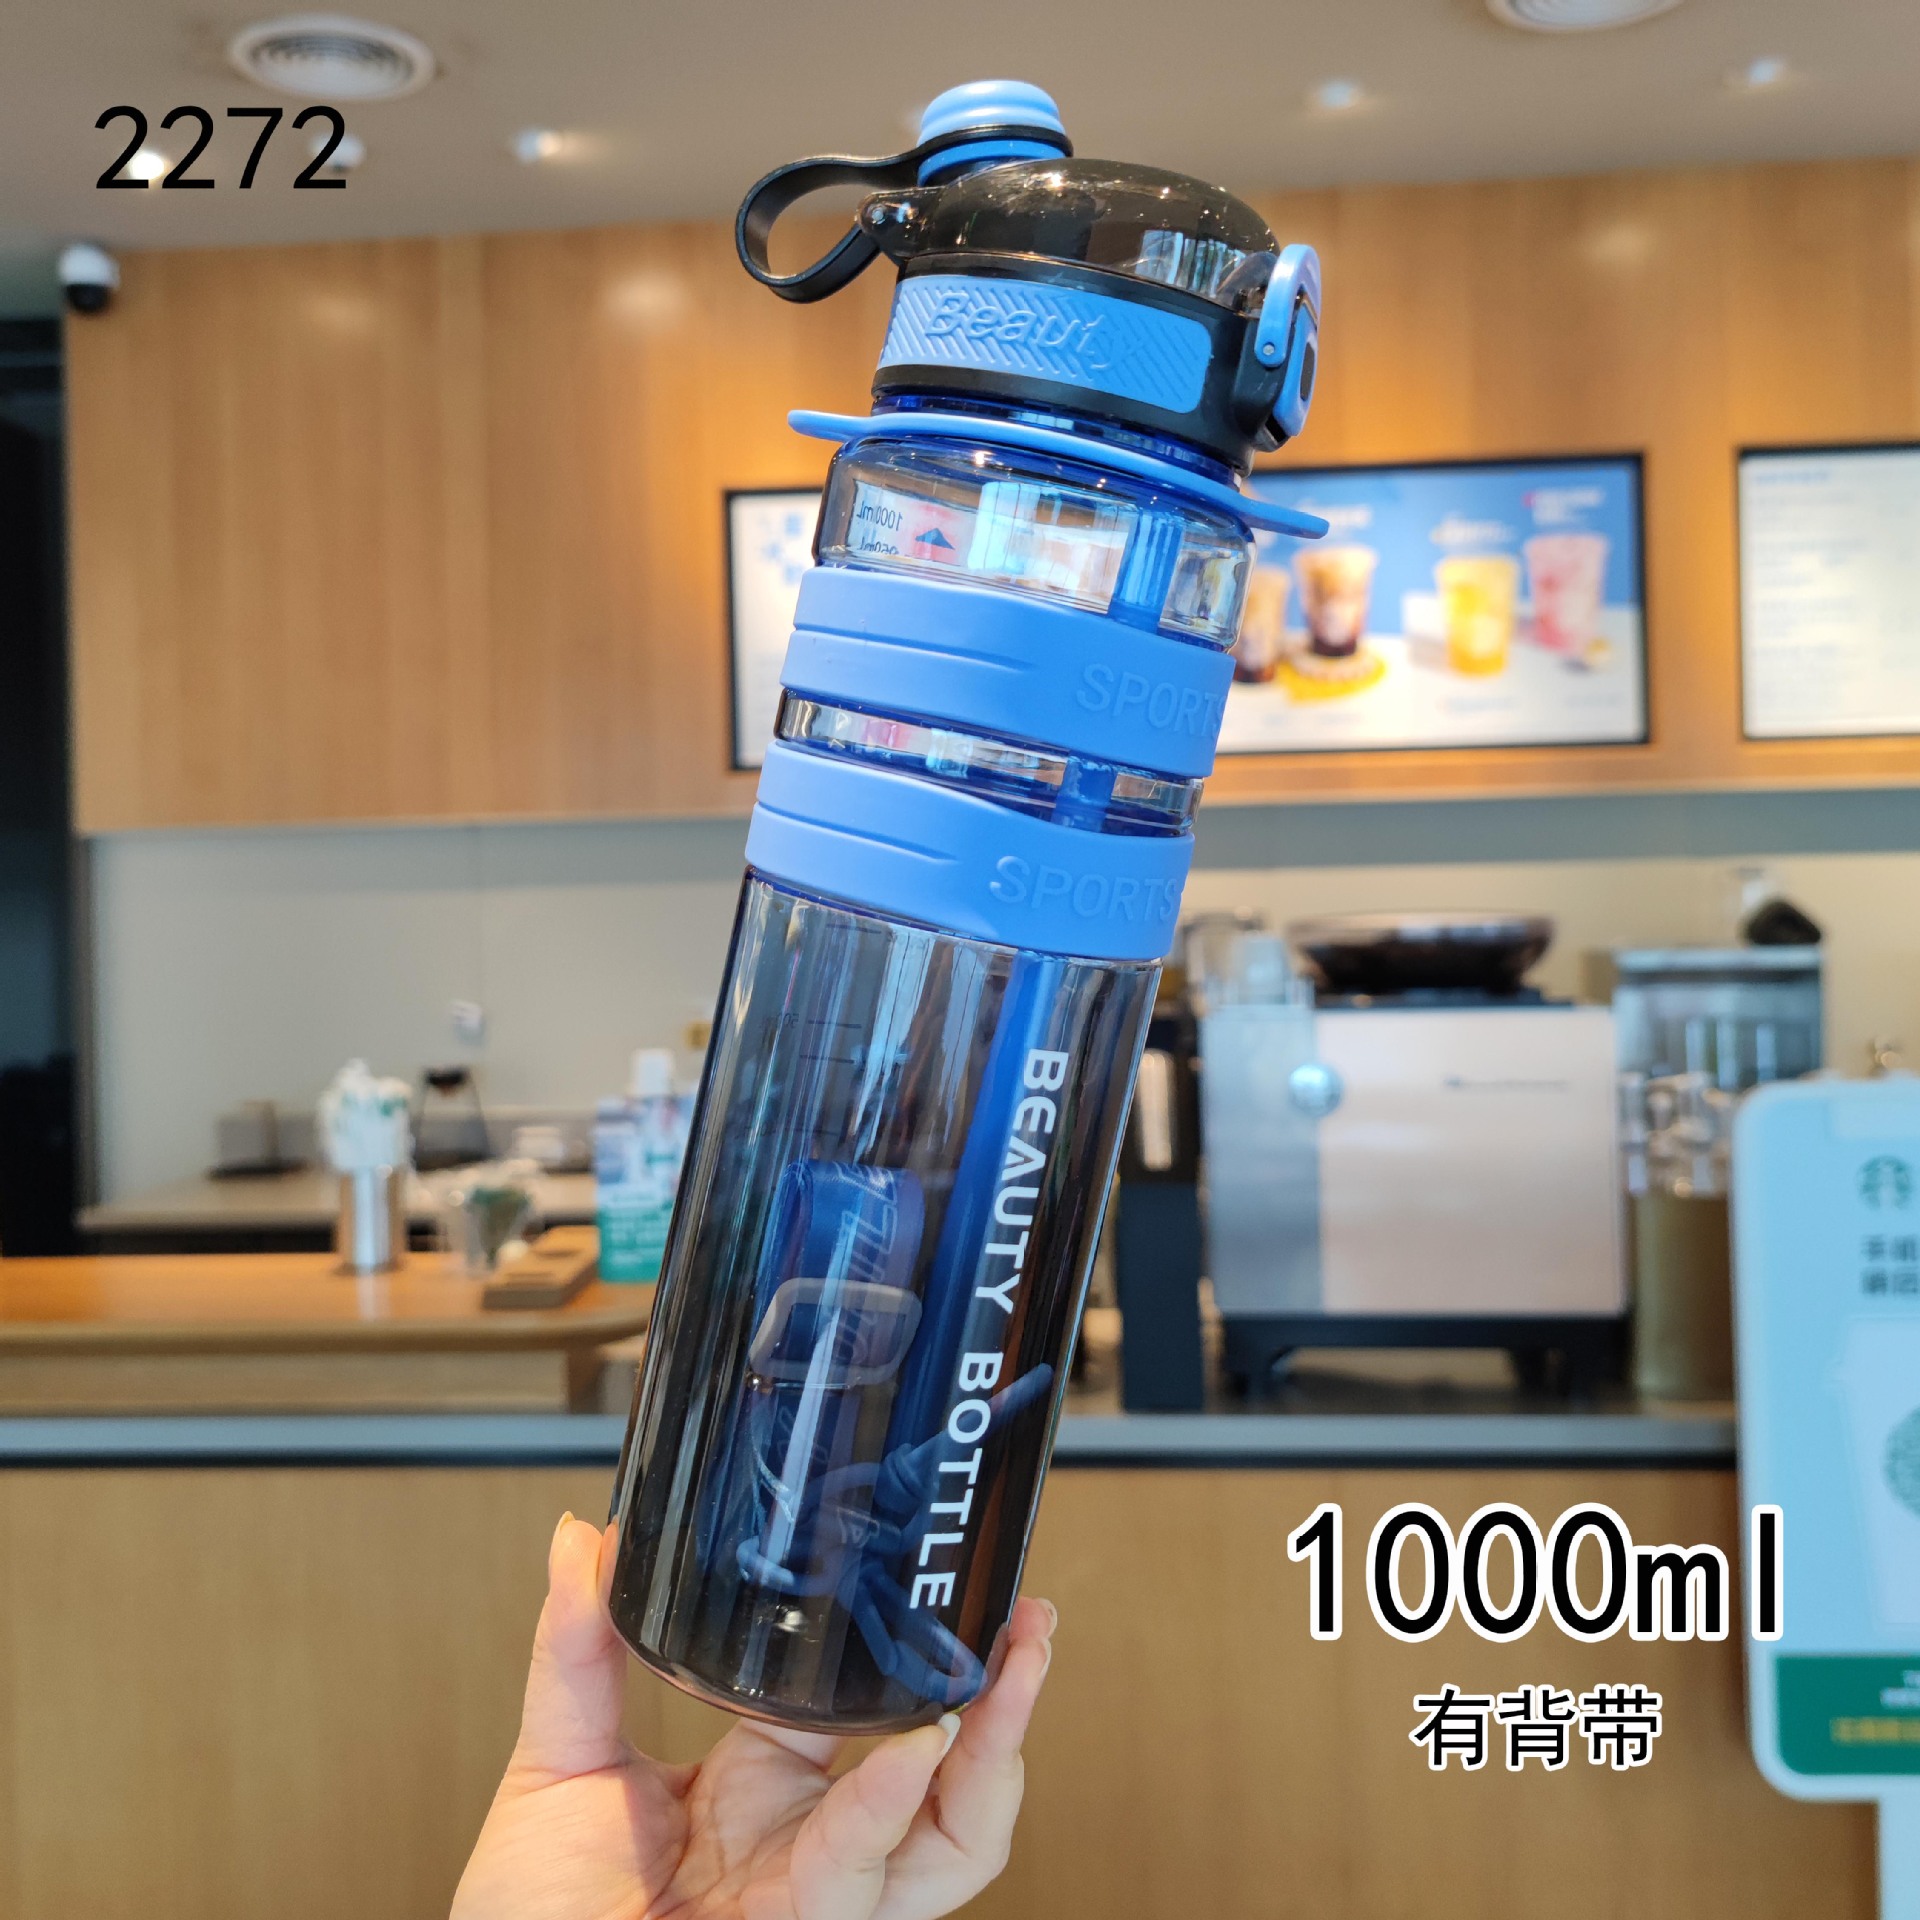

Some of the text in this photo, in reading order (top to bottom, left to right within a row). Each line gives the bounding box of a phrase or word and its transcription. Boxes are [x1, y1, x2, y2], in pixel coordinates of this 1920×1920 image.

[990, 855, 1178, 921] SPORTS
[911, 1050, 1068, 1607] BEAUTY BOTTLE
